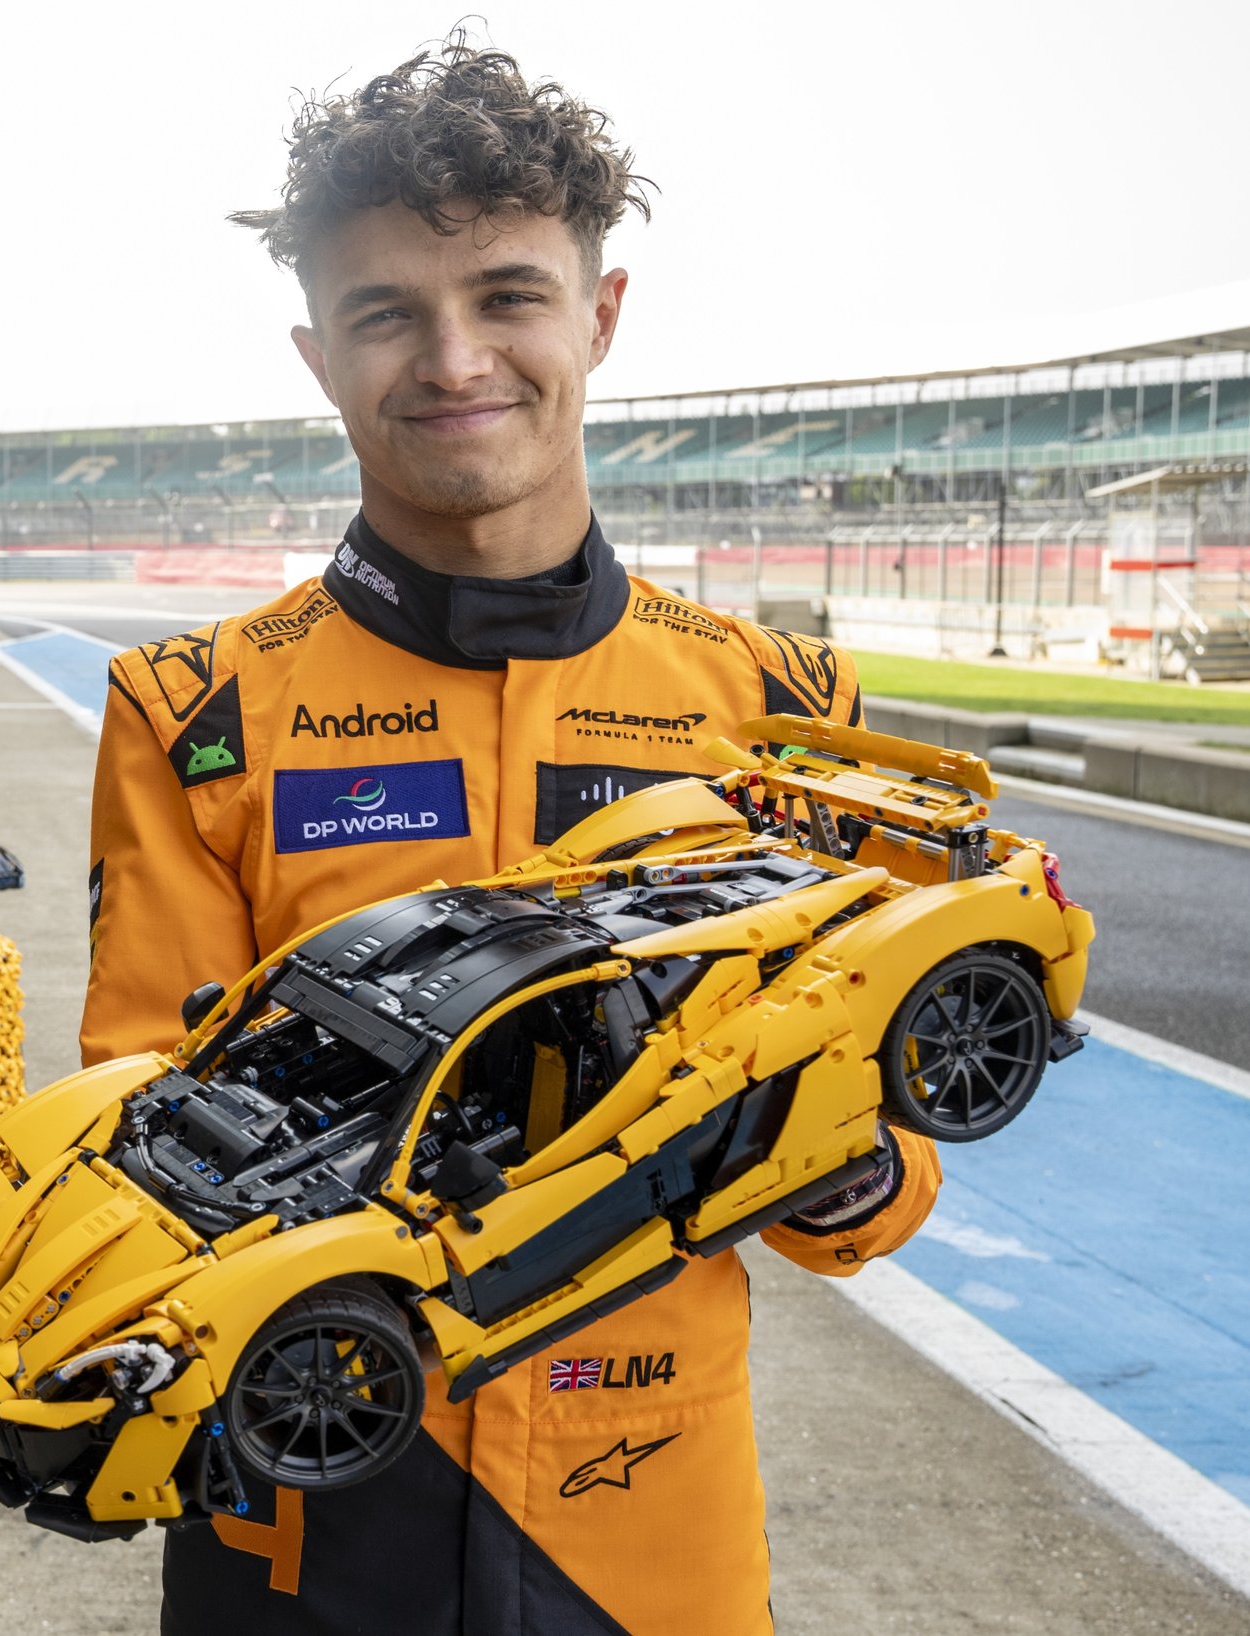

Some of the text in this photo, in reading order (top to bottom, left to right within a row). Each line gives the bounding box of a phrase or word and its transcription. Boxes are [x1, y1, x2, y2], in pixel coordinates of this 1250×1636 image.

[354, 569, 400, 606] NUTRITION
[358, 560, 396, 593] OPTIMUM
[251, 598, 325, 637] Hilton
[258, 639, 284, 653] FOR
[310, 604, 338, 624] STAY
[642, 601, 722, 632] Hilton
[663, 619, 690, 634] THE
[694, 628, 728, 645] STAY
[290, 699, 439, 739] Android
[555, 707, 692, 732] McLaren
[576, 728, 639, 741] FORMULA
[658, 734, 694, 746] TEAM
[303, 811, 439, 839] DP WORLD
[602, 1352, 676, 1388] LN4
